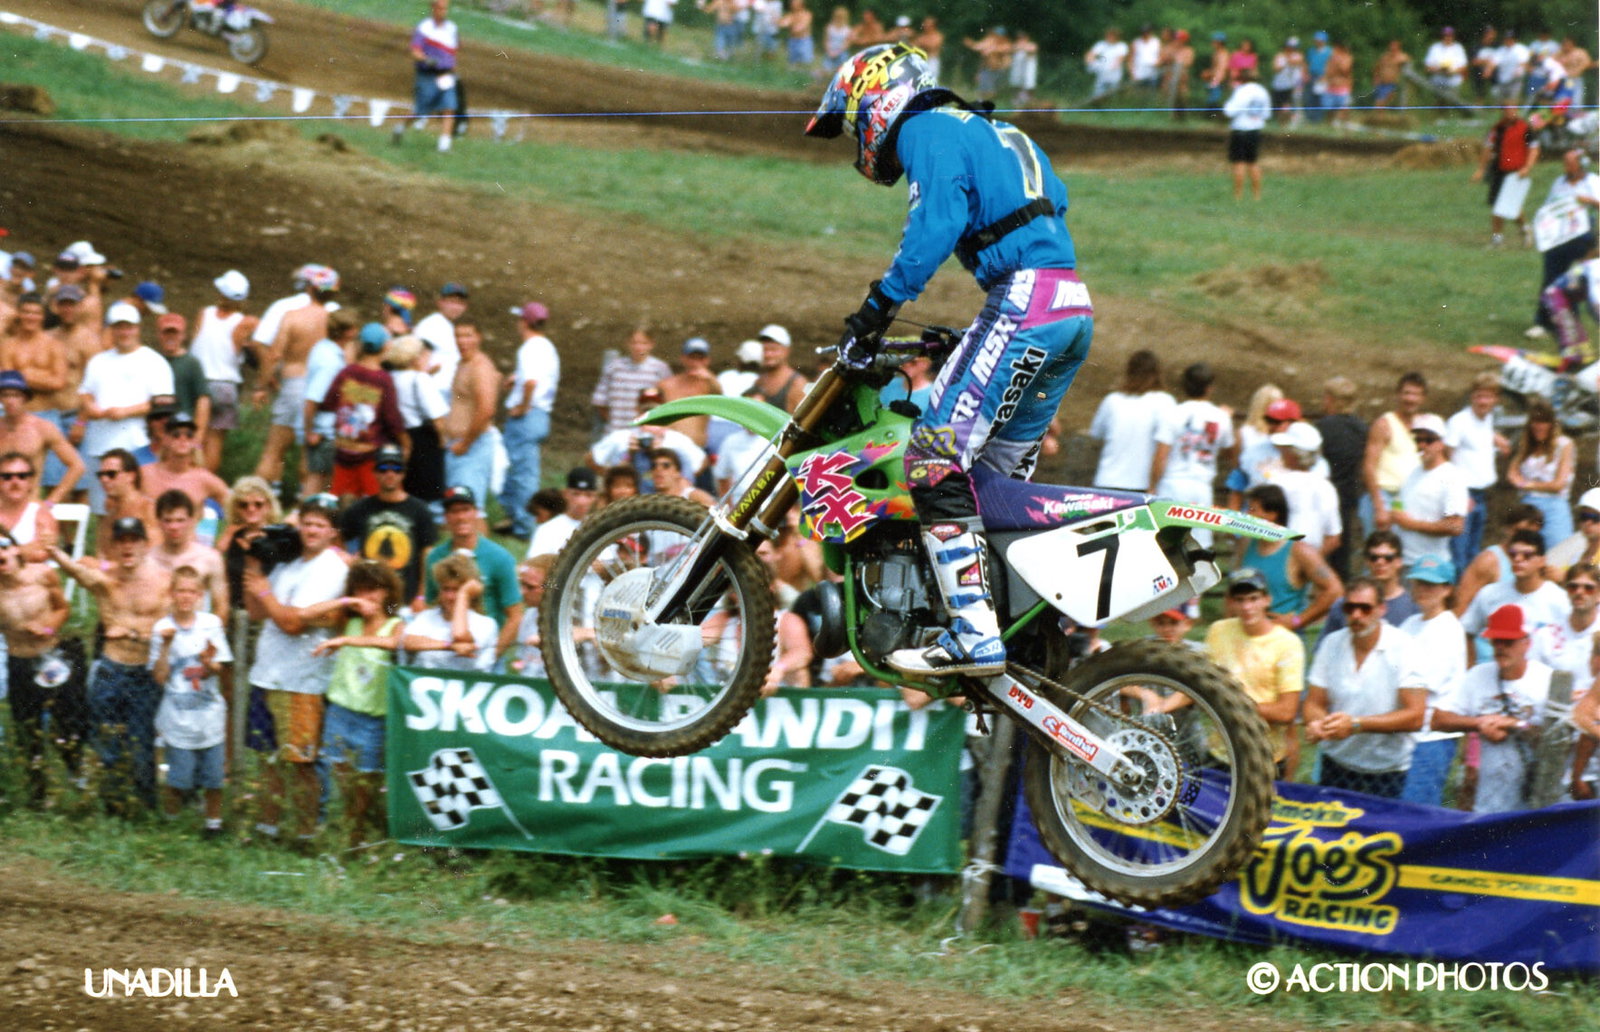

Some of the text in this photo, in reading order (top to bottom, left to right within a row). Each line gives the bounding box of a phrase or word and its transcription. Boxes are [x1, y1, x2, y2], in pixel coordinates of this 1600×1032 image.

[882, 91, 905, 113] BELL
[1008, 269, 1036, 312] MS
[970, 313, 1018, 387] MSR
[730, 470, 776, 522] KAYABA
[797, 451, 879, 541] KX
[1043, 496, 1115, 515] Kawasaki
[1166, 506, 1223, 526] MOTUL
[1076, 533, 1120, 621] 7
[406, 677, 617, 743] SKOA
[538, 749, 807, 813] RACING
[1284, 900, 1391, 930] RACING
